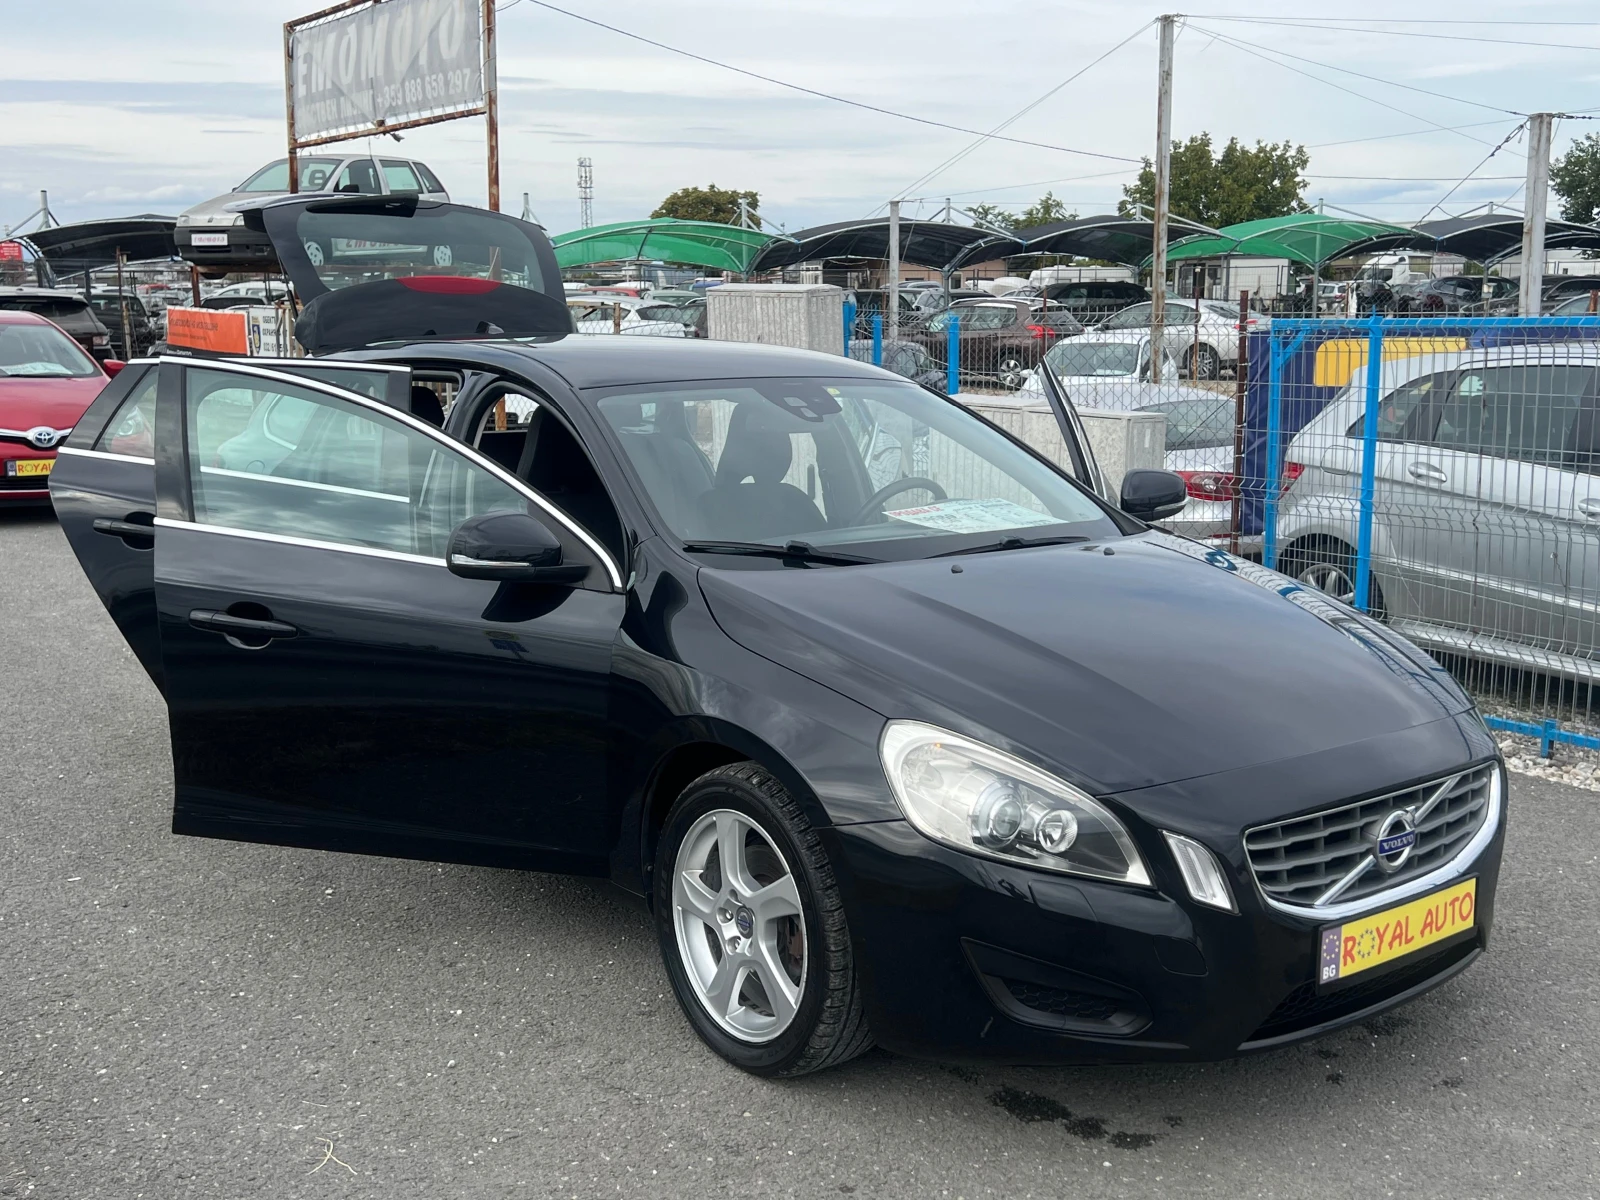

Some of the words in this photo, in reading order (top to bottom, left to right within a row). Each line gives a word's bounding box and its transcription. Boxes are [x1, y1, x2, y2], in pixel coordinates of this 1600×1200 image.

[377, 86, 404, 109] +359
[405, 77, 423, 104] 888
[425, 72, 445, 100] 658
[447, 67, 471, 94] 297
[1382, 834, 1414, 850] VOLVO
[1342, 915, 1415, 967] ROYAL
[1419, 892, 1474, 938] AUTO
[1322, 964, 1337, 980] BG
